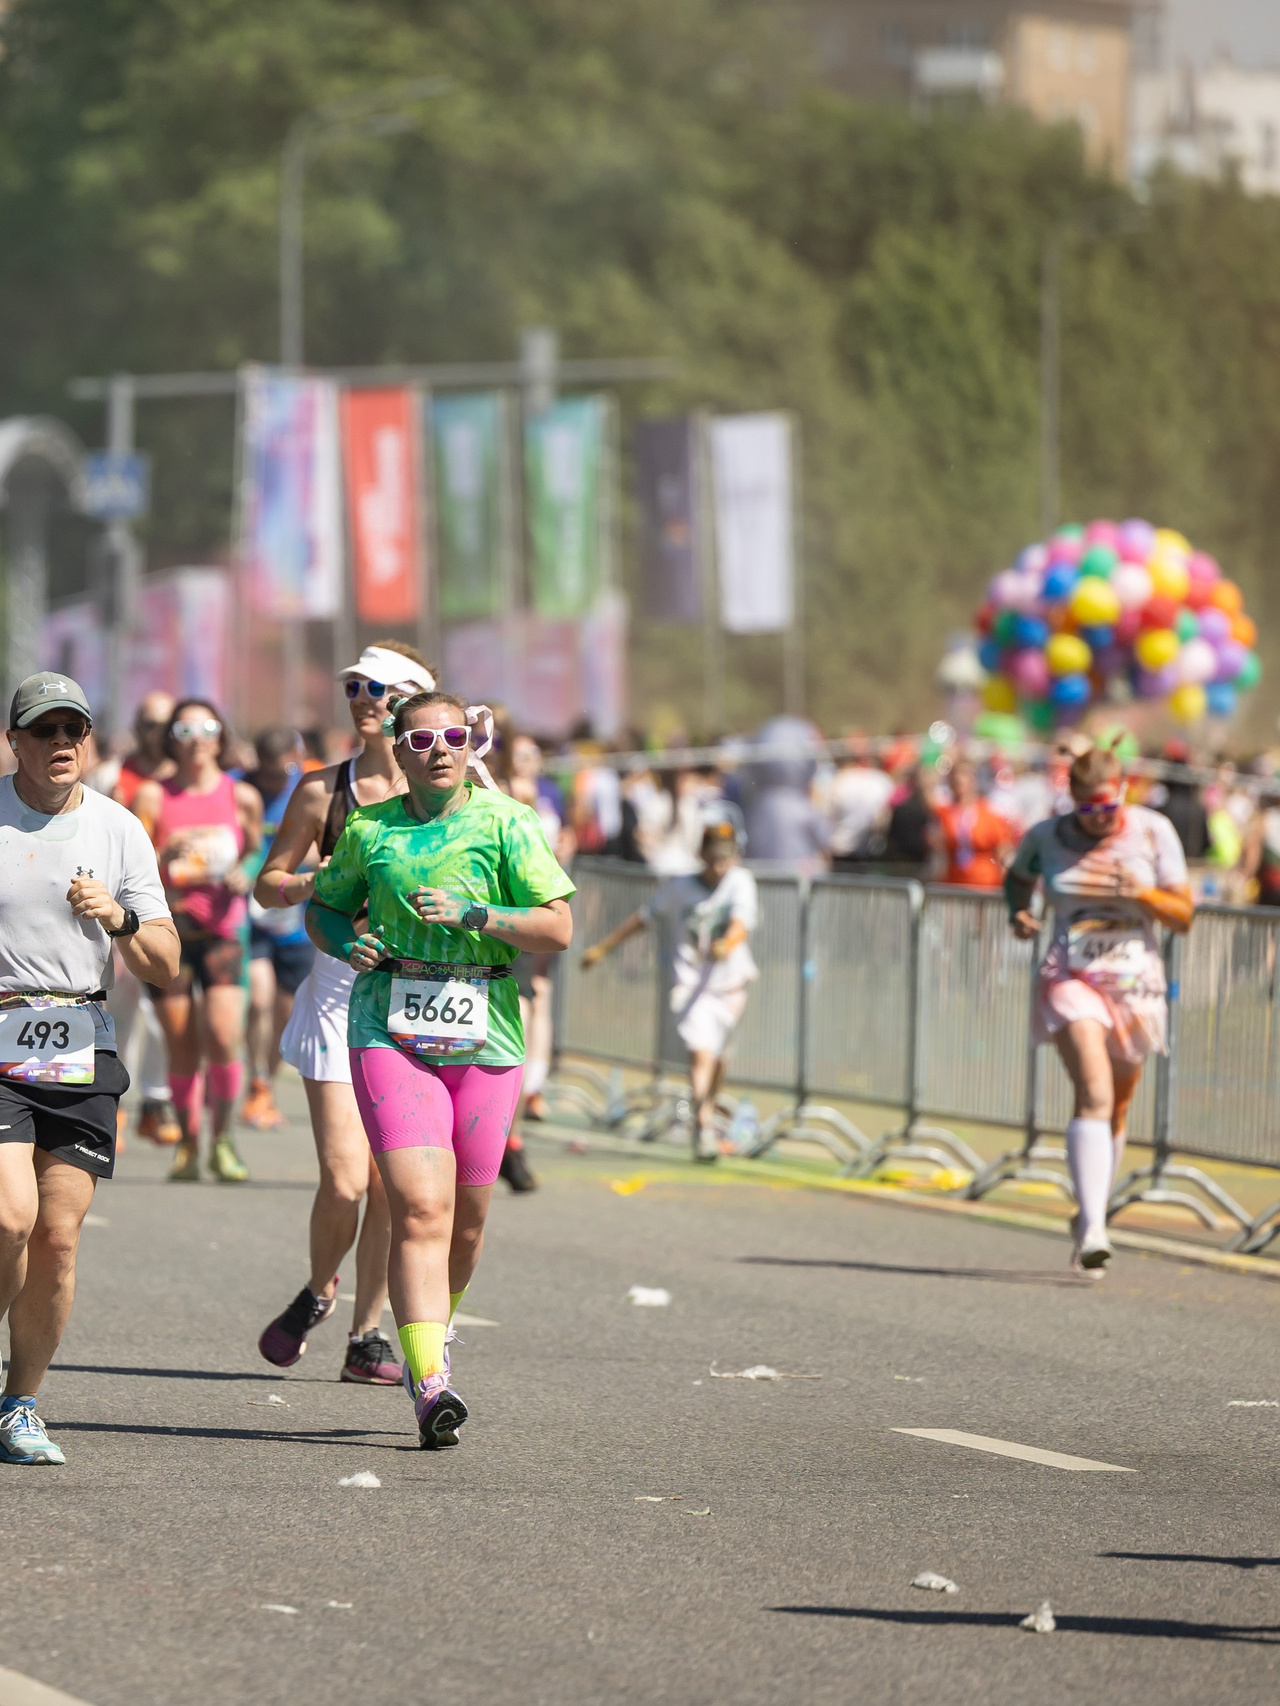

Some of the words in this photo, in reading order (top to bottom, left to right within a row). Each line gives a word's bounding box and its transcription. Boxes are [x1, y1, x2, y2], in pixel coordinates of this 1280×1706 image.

[404, 993, 474, 1025] 5662
[17, 1021, 70, 1050] 493
[80, 1146, 98, 1158] PROJECT
[97, 1154, 110, 1163] ROCK
